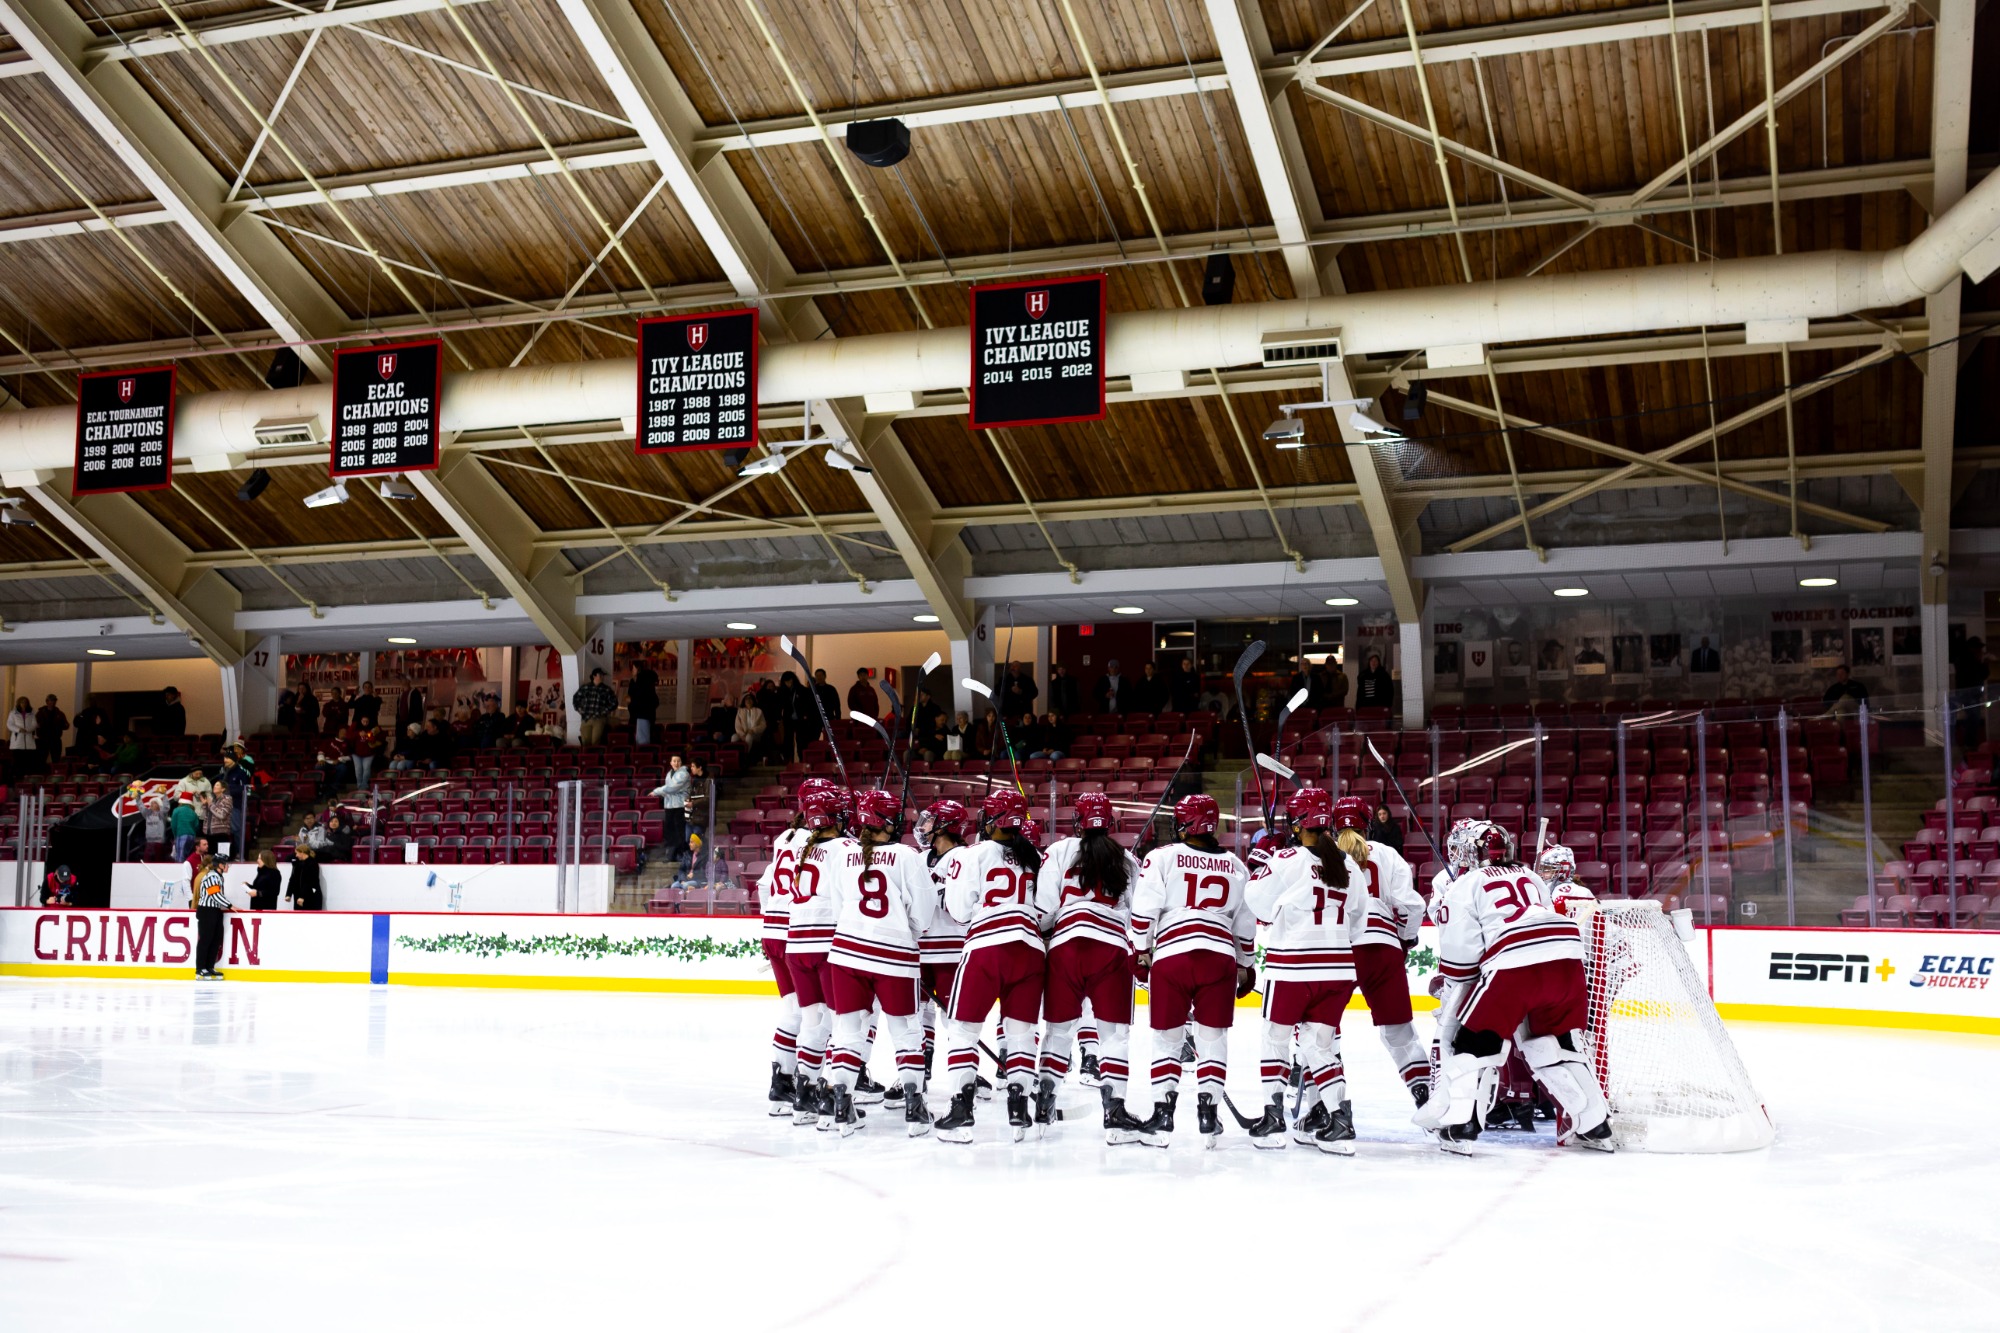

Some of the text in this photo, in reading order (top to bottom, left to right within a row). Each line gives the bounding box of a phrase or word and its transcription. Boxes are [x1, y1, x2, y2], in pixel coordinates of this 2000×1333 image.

[1031, 294, 1043, 312] H
[692, 327, 703, 344] H
[986, 320, 1089, 345] IVY LEAGUE
[984, 340, 1090, 366] CHAMPIONS
[382, 357, 392, 373] H
[651, 352, 744, 375] IVY LEAGUE
[650, 371, 745, 394] CHAMPIONS
[984, 363, 1092, 384] 2014 2015 2022
[122, 381, 131, 396] H
[367, 382, 404, 400] ECAC
[343, 398, 428, 420] CHAMPIONS
[649, 393, 745, 412] 1987 1988 1989
[86, 406, 164, 424] ECAC TOURNAMENT
[648, 410, 745, 428] 1999 2003 2005
[86, 421, 163, 441] CHAMPIONS
[342, 419, 428, 437] 1999 2003 2004
[648, 426, 745, 444] 2008 2009 2013
[84, 440, 162, 457] 1999 2004 2005
[341, 434, 428, 452] 2005 2008 2009
[84, 455, 161, 471] 2006 2008 2015
[340, 452, 396, 467] 2015 2022
[1772, 606, 1914, 622] WOMEN'S COACHING
[1358, 625, 1395, 637] MEN'S
[591, 638, 604, 655] 16
[254, 652, 269, 667] 17
[700, 656, 755, 670] HOCKEY
[302, 668, 357, 683] CRIMSON
[847, 852, 896, 867] FINEGAN
[856, 870, 888, 918] 8
[1184, 873, 1230, 910] 12
[1483, 876, 1542, 923] 30
[1313, 886, 1347, 925] 17
[34, 914, 262, 966] CRIMSN
[1919, 955, 1995, 975] ECAC
[1927, 975, 1990, 990] HOCKEY
